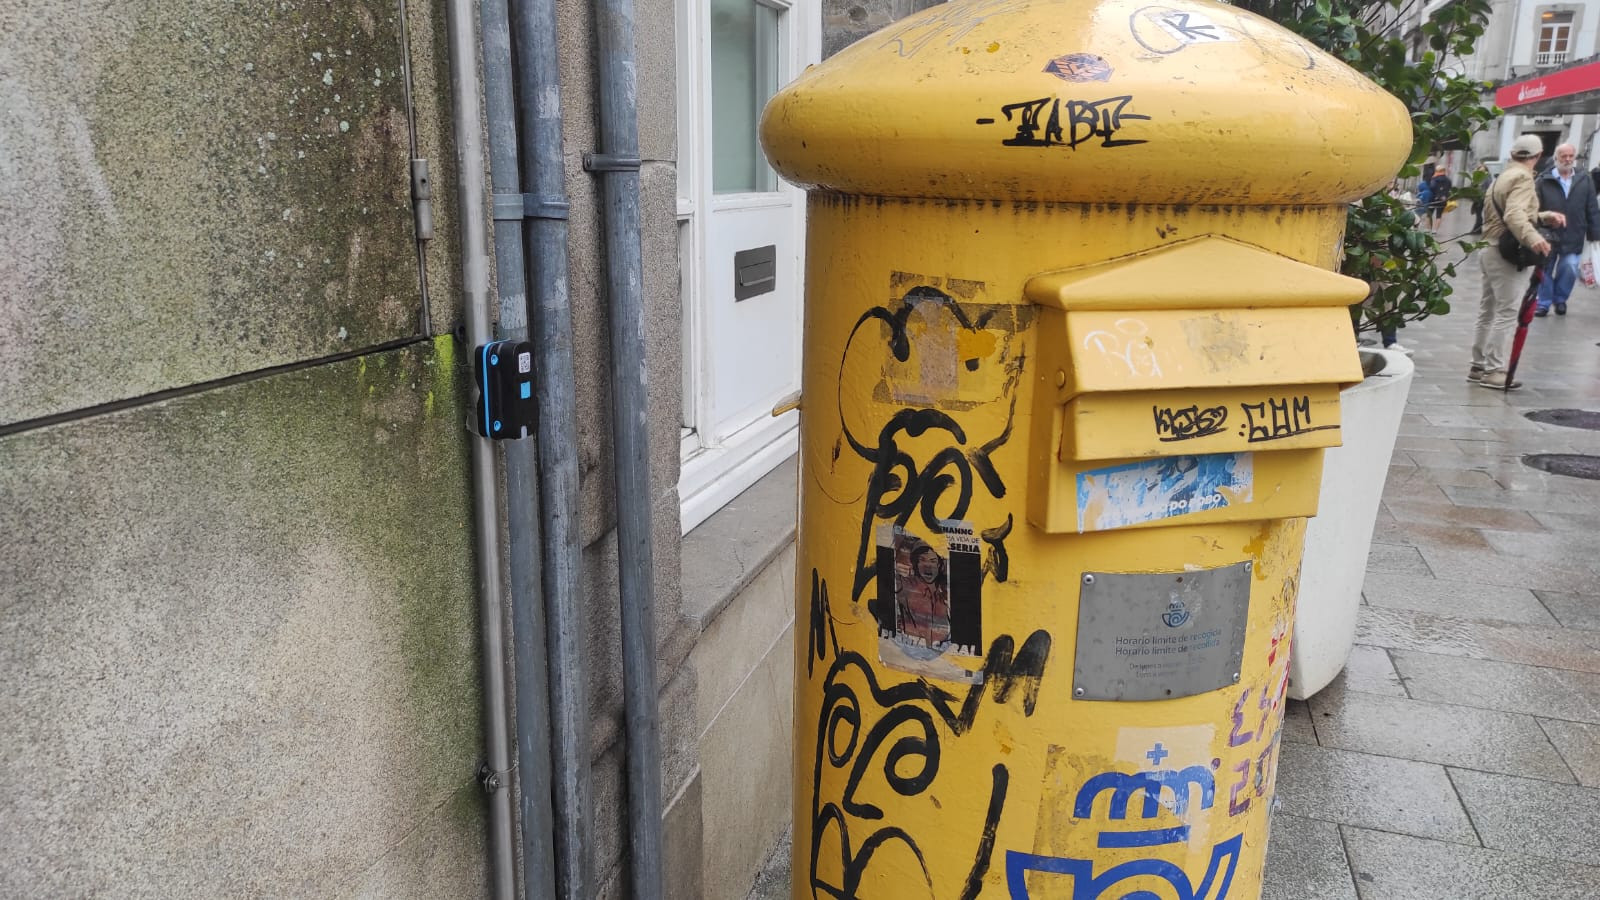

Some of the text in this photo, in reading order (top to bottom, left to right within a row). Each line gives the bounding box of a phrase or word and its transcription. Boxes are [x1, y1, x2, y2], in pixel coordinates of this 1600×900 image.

[947, 542, 980, 553] SERIA
[1115, 635, 1150, 645] Horario
[1178, 633, 1189, 642] de
[1115, 647, 1150, 656] Horario
[1178, 645, 1188, 653] de
